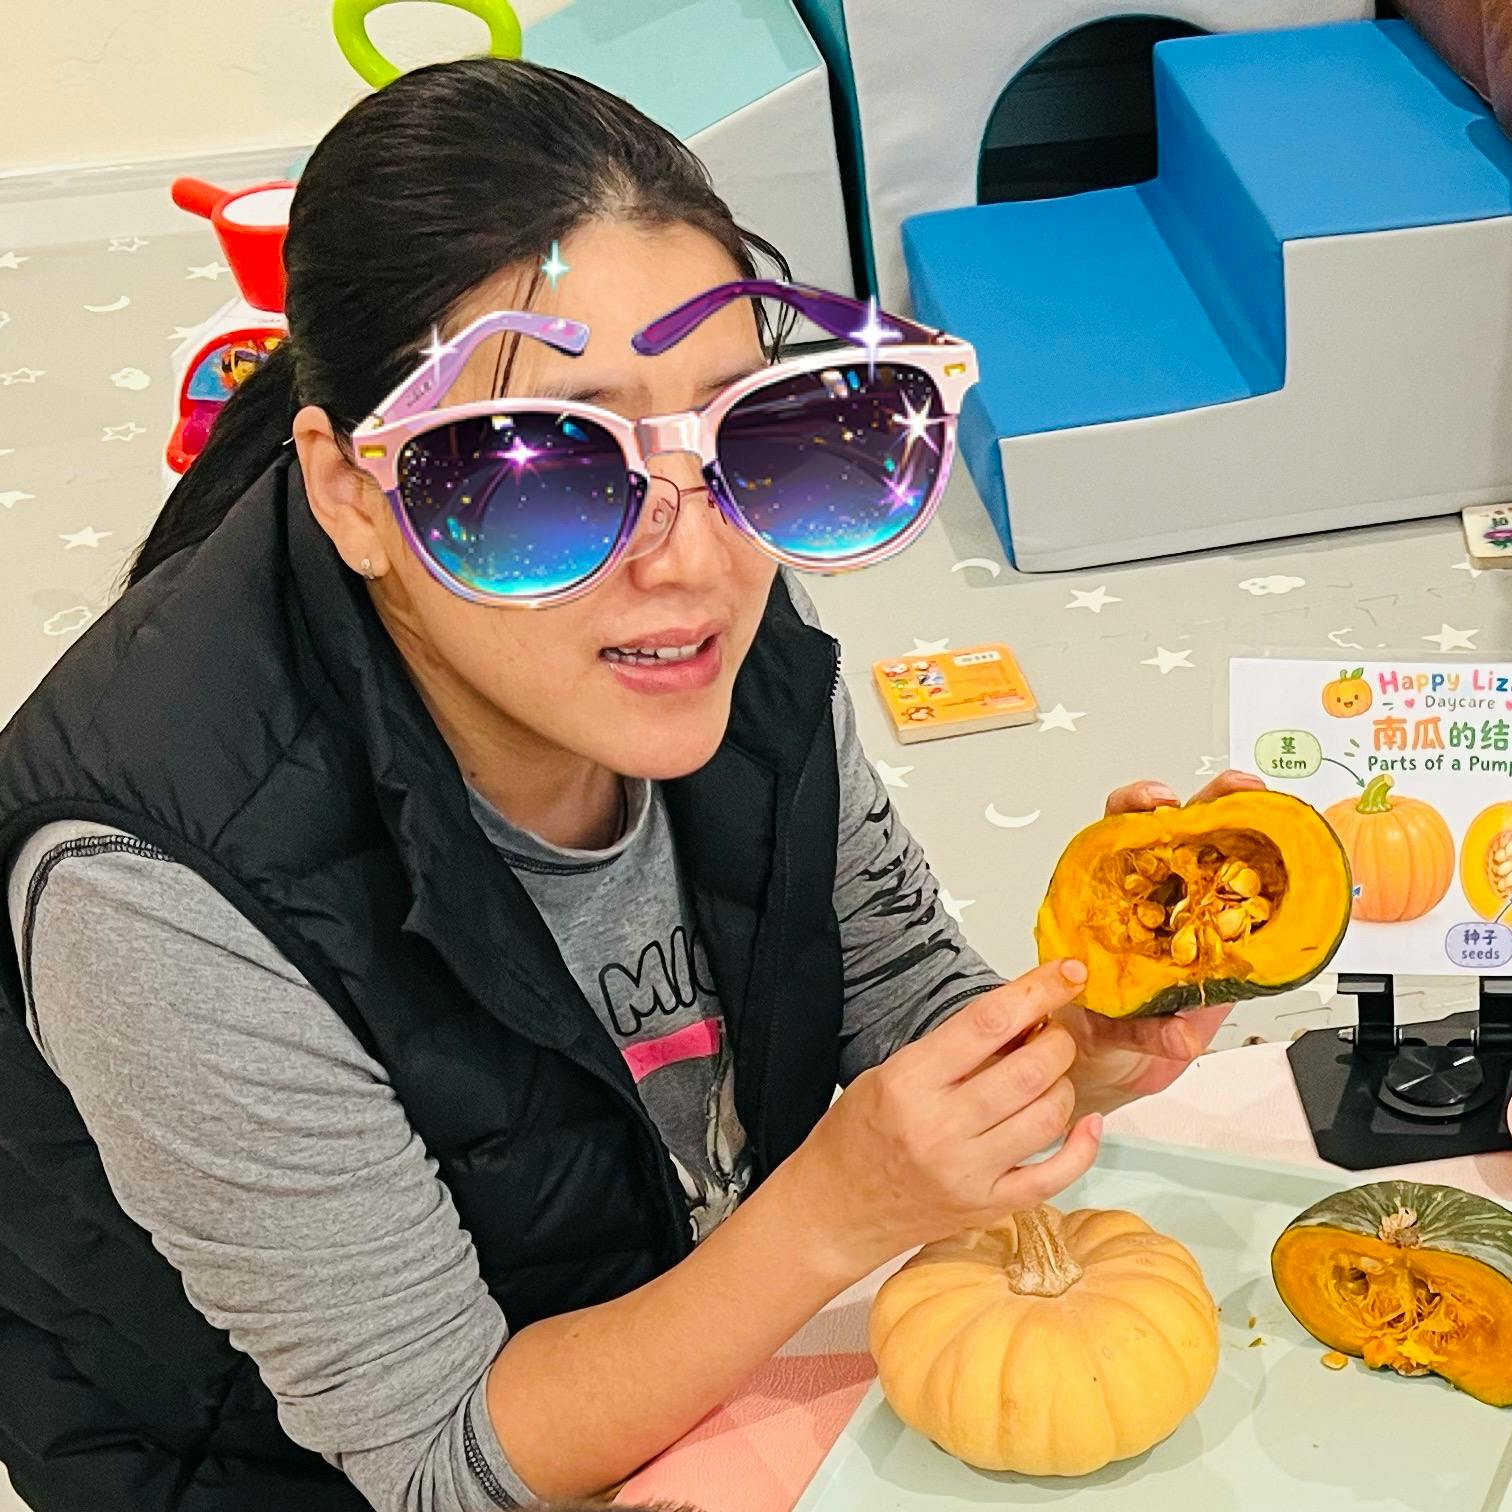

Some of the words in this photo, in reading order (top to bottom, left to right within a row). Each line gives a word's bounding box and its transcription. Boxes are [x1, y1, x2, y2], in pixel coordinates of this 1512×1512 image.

[1378, 669, 1461, 697] Happy
[1424, 695, 1496, 712] Daycare
[1280, 736, 1297, 755] 茎
[1271, 757, 1308, 770] stem
[1368, 755, 1419, 772] Parts
[1424, 755, 1445, 772] of
[1451, 760, 1462, 771] a
[1463, 929, 1498, 946] 种子
[1461, 948, 1500, 960] seeds
